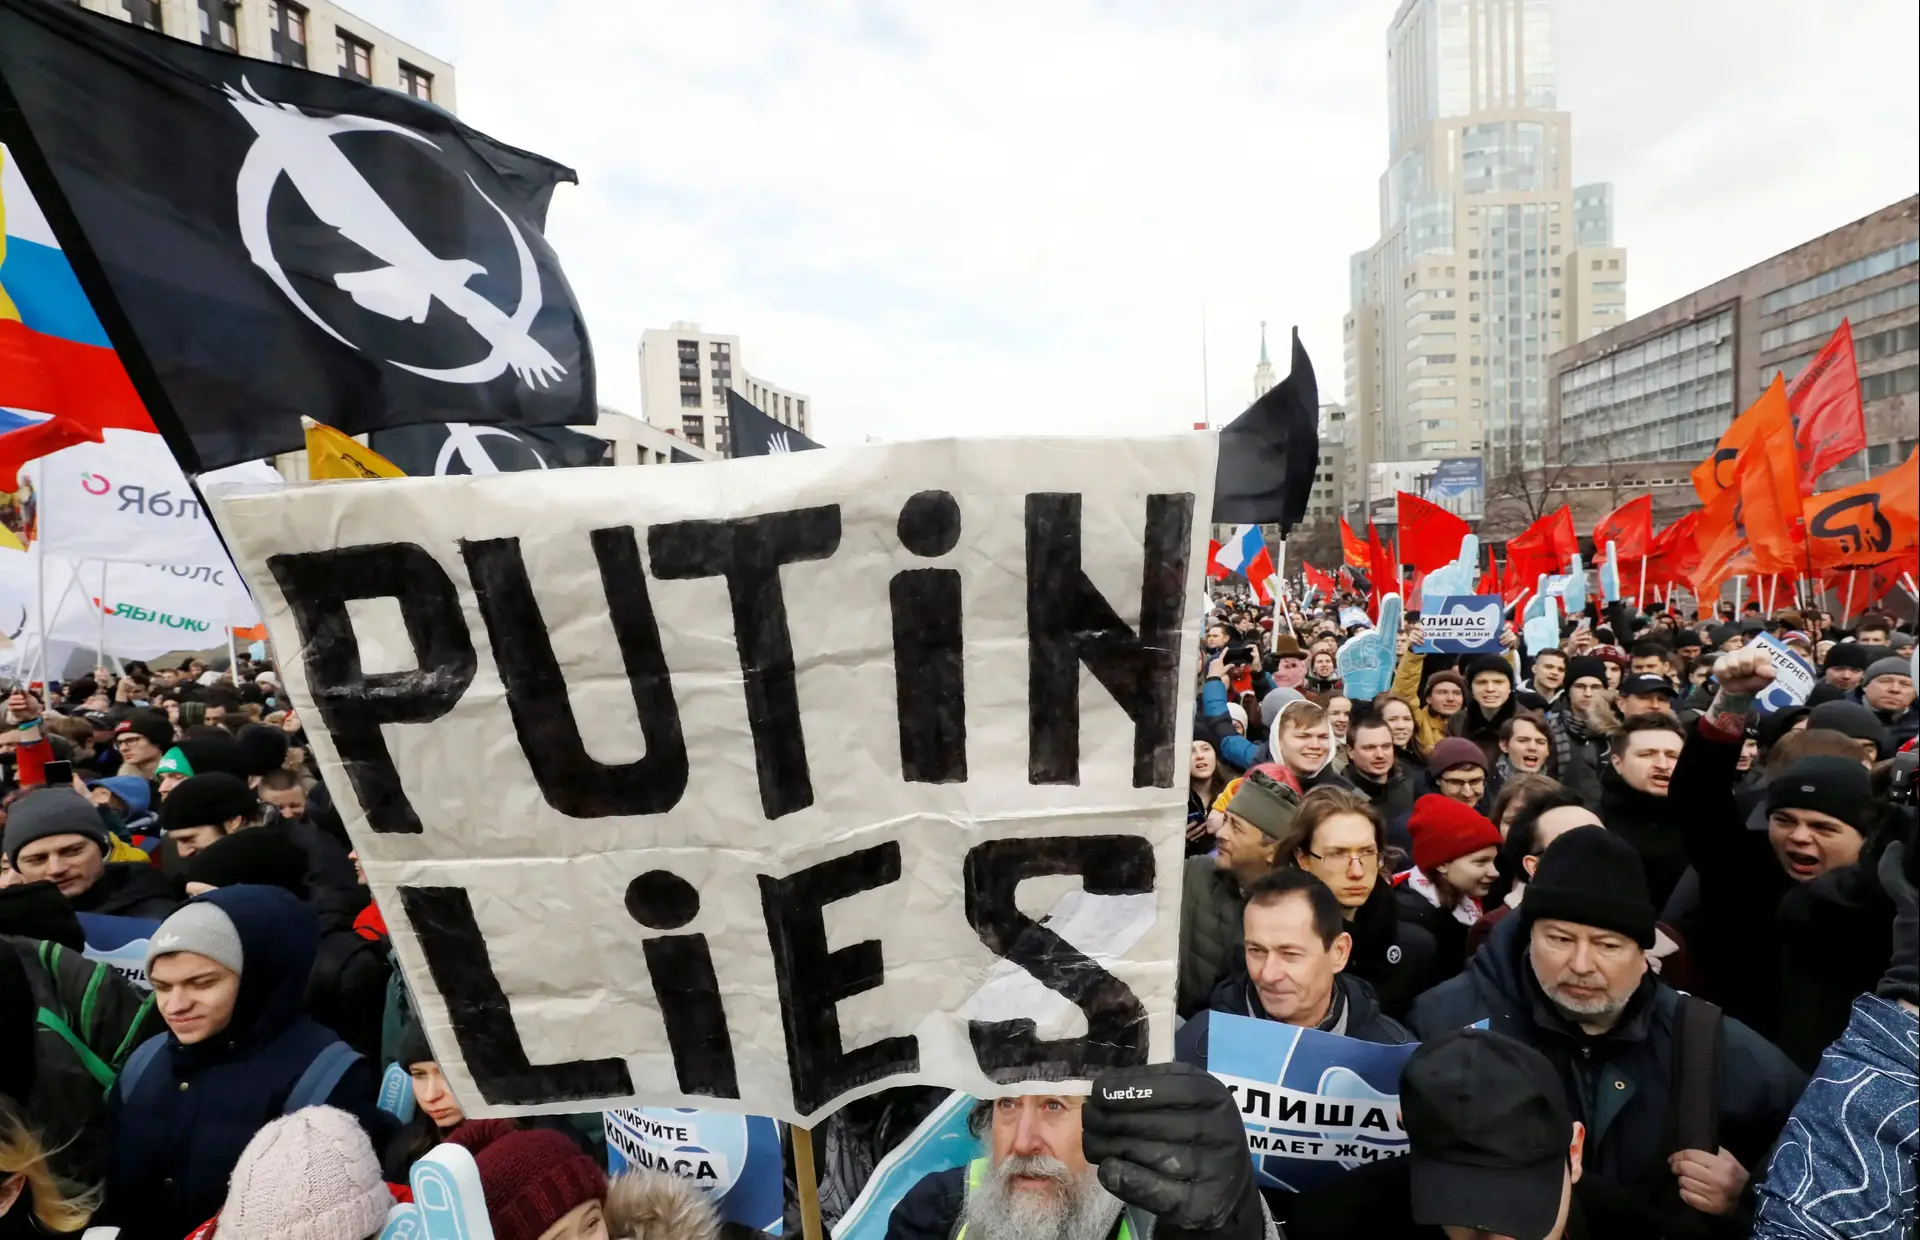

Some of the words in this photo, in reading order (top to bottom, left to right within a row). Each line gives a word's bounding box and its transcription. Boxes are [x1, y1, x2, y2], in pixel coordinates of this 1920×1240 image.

[117, 485, 206, 519] Ябл
[1228, 1084, 1406, 1132] ЛИША
[1250, 1135, 1324, 1156] МАЕТ
